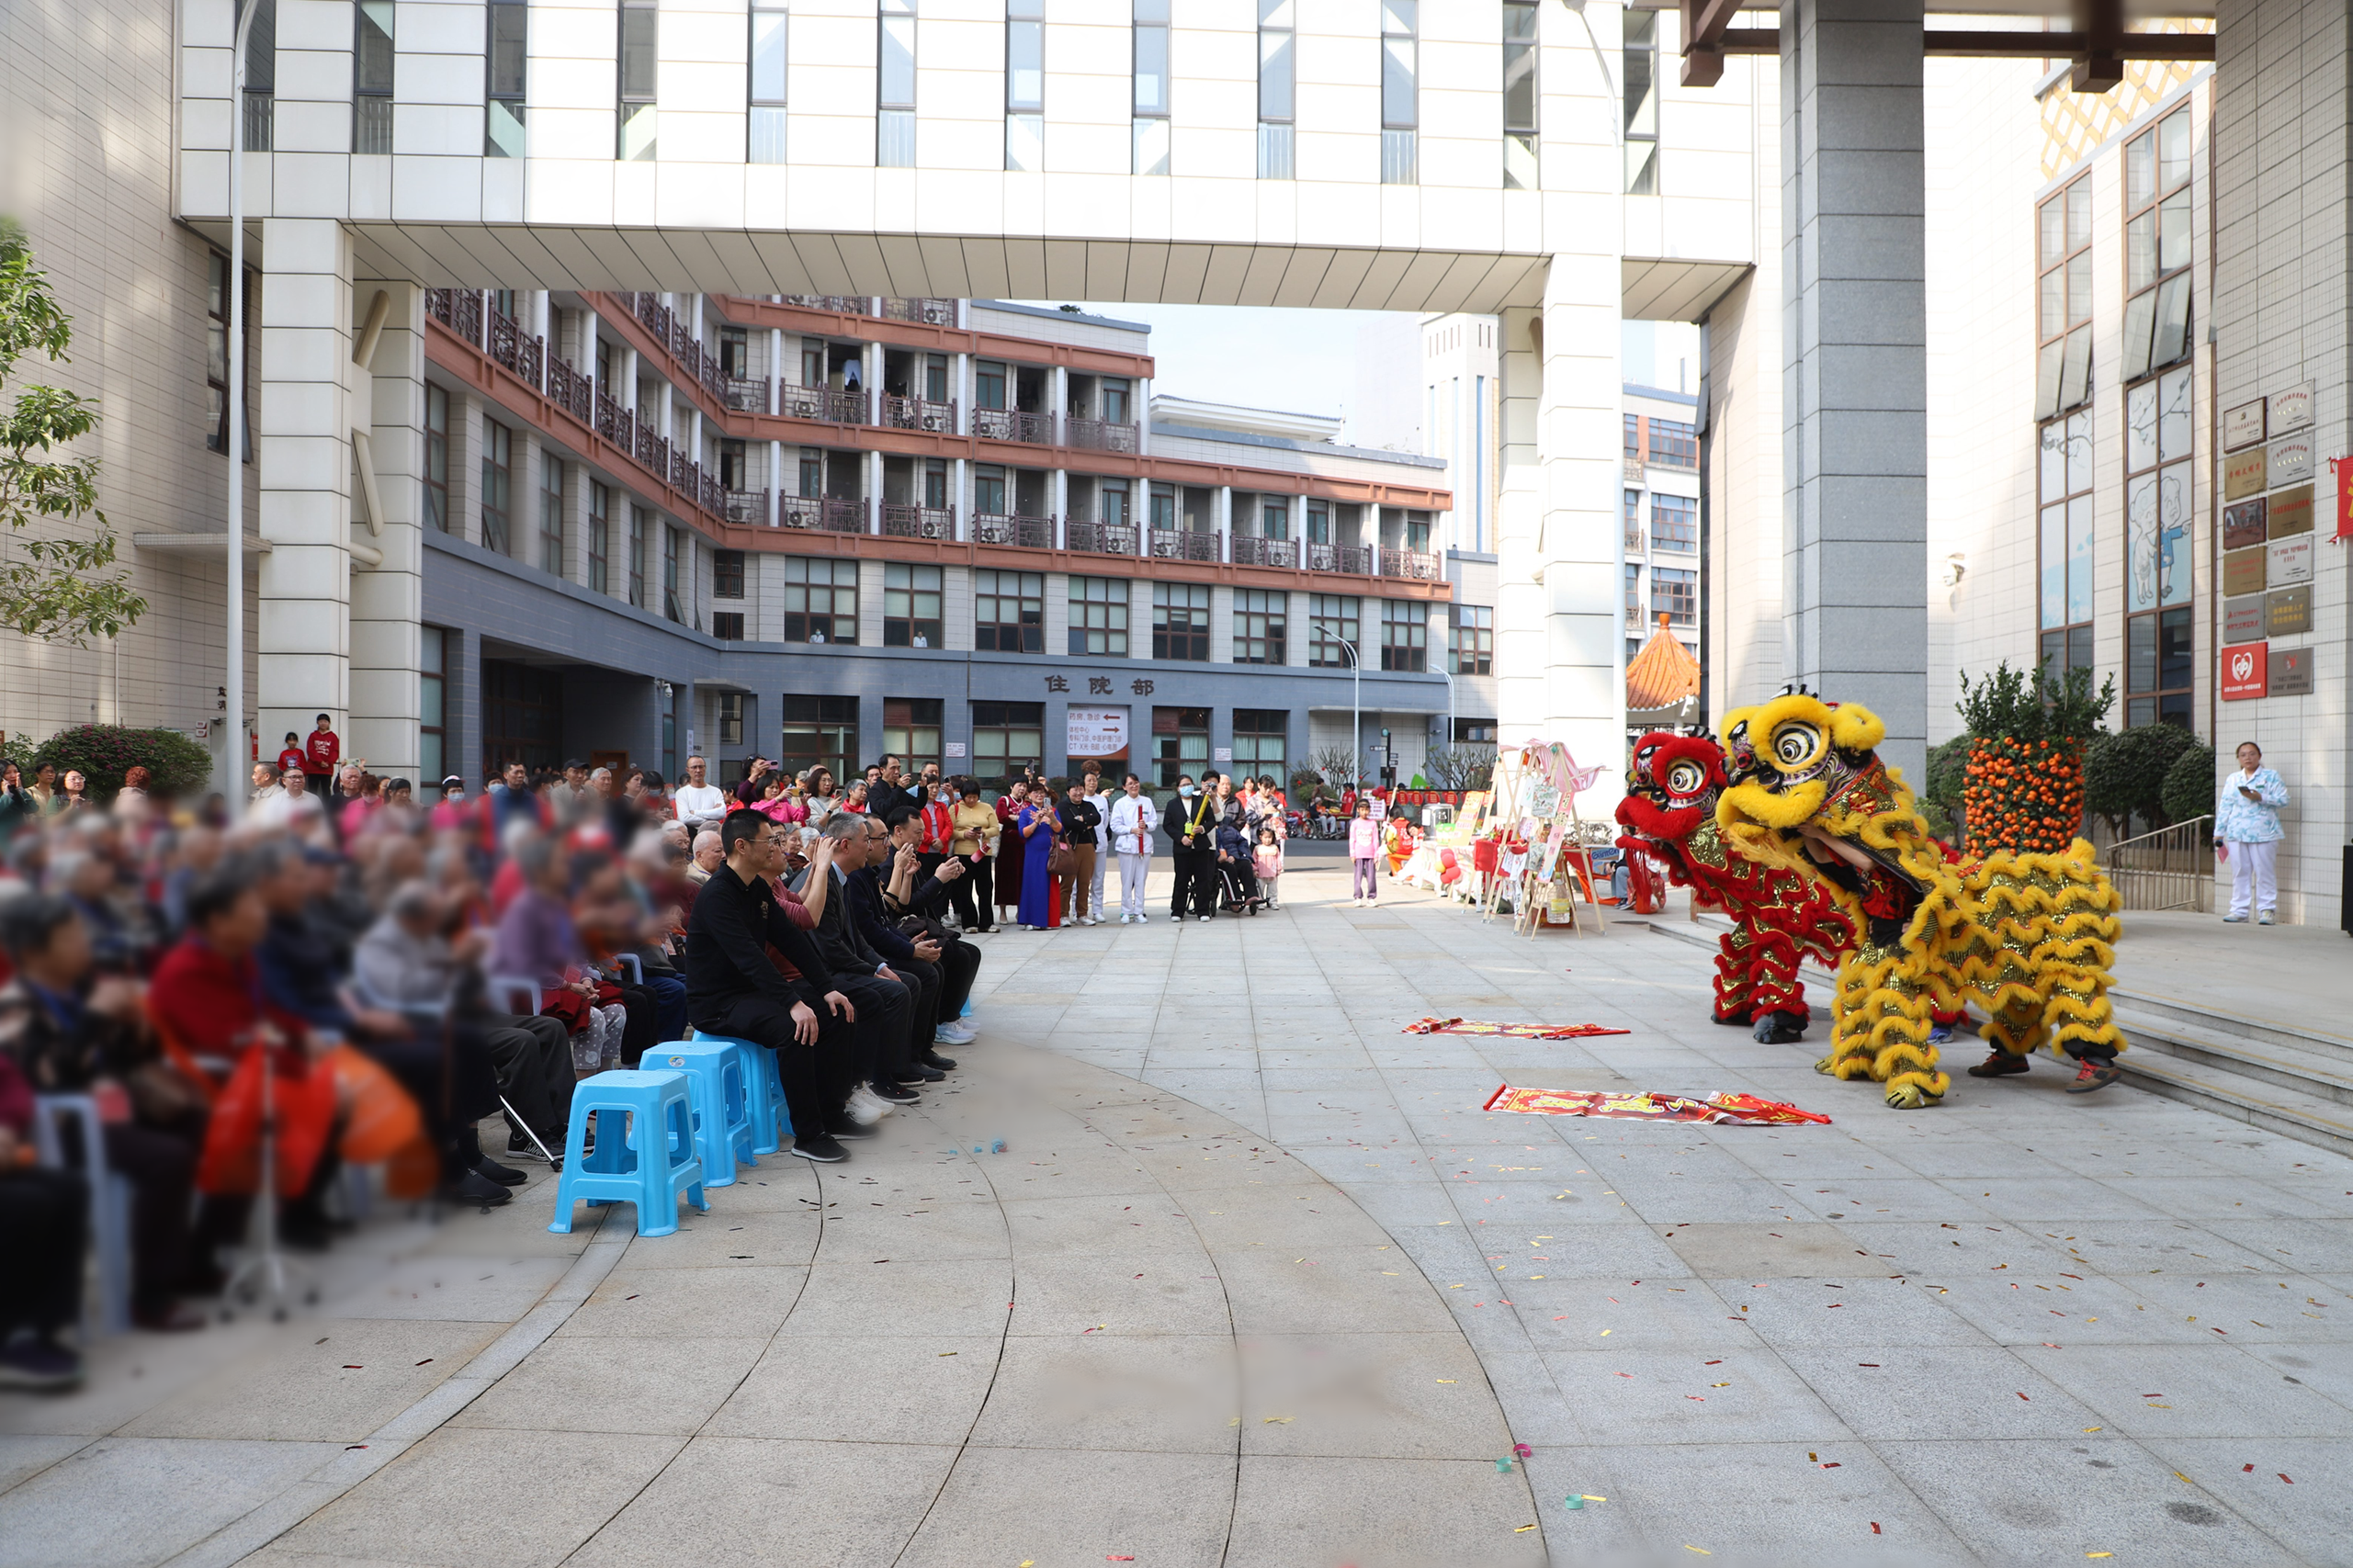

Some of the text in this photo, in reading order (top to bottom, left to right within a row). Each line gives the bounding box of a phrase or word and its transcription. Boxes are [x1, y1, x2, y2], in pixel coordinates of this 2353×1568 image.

[1044, 674, 1155, 696] 住院部
[1069, 712, 1101, 722] 药房、急诊
[1069, 726, 1090, 734] 体检中心
